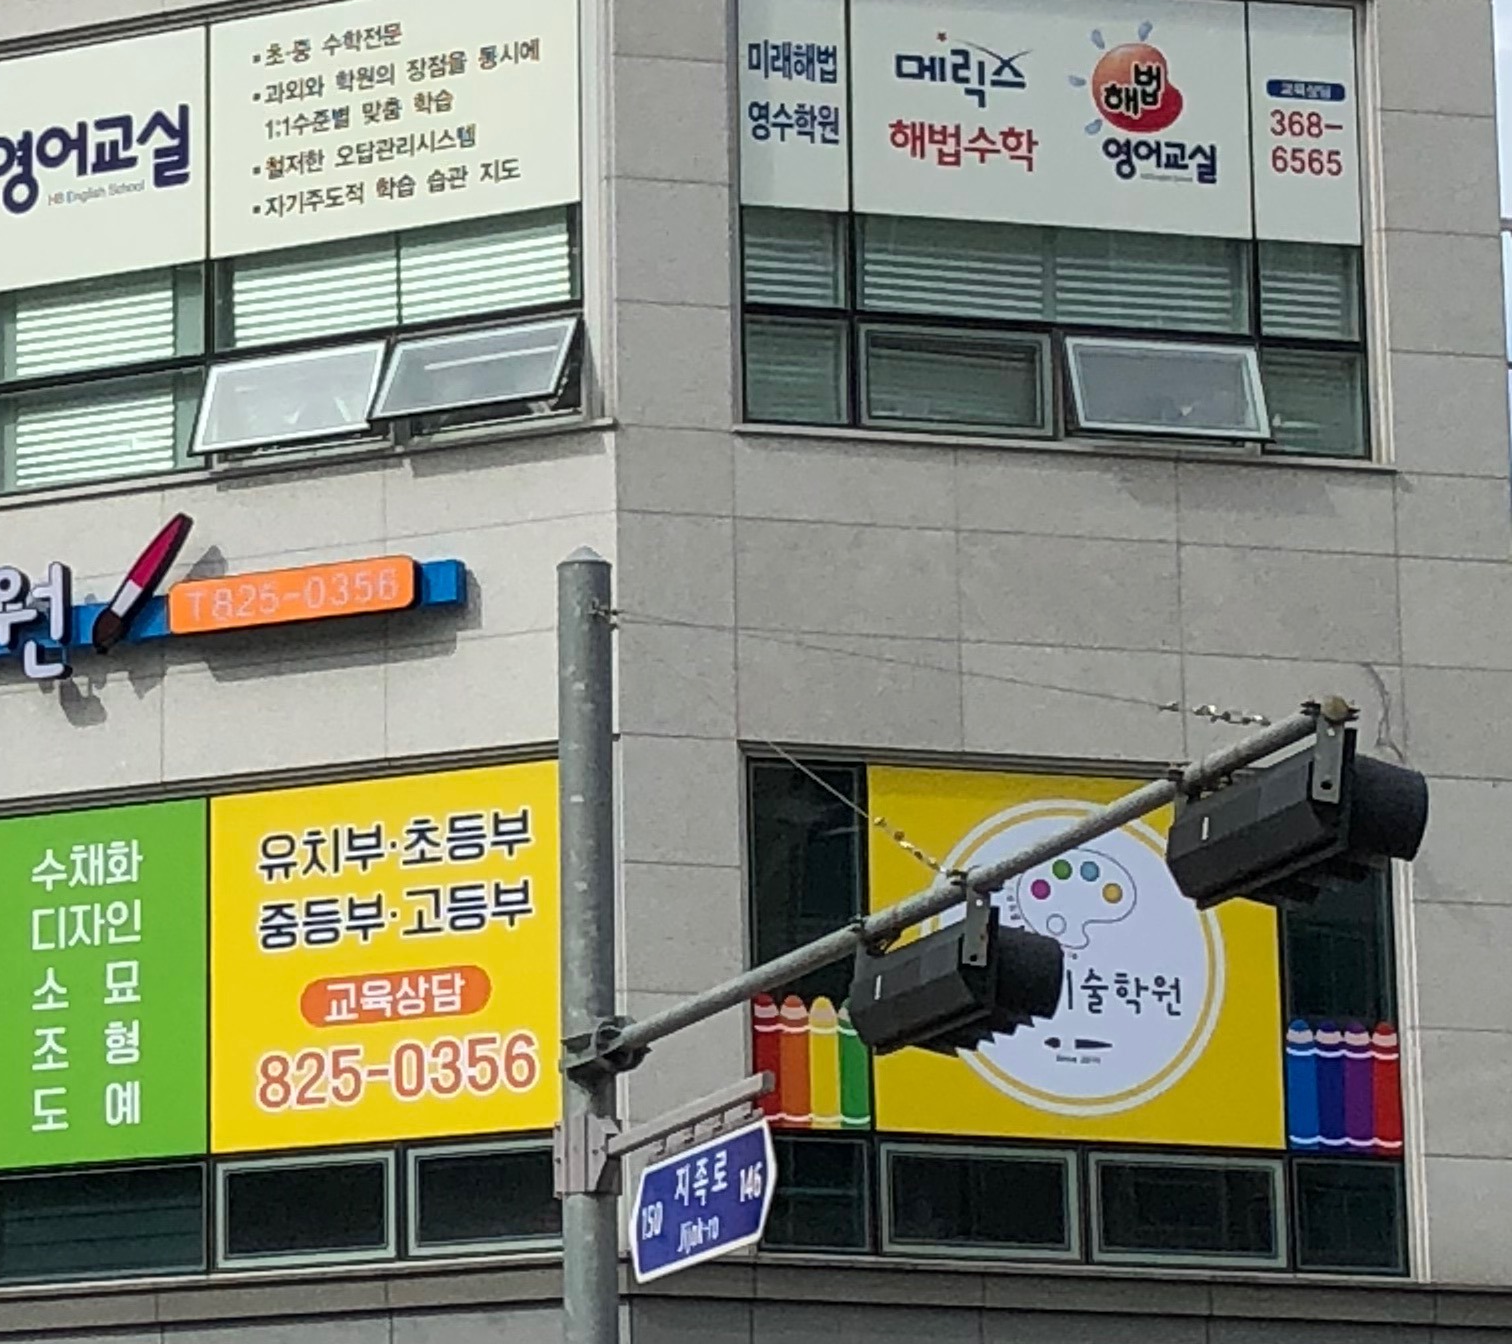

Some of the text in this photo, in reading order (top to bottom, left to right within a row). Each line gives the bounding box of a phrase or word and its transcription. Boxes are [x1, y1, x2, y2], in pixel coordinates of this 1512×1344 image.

[322, 22, 402, 55] 수학전문
[747, 39, 839, 85] 미래해법
[264, 38, 540, 104] 과외와 학원의 장점을 동시에
[895, 48, 1027, 108] 메릭스
[1102, 61, 1164, 116] 해법
[362, 97, 402, 126] 맞춤
[413, 89, 454, 114] 학습
[747, 101, 840, 146] 영수학원
[265, 123, 477, 180] 철저한 오답관리시스템
[889, 118, 1039, 172] 해법수학
[1102, 137, 1218, 184] 영어교실
[1271, 145, 1343, 176] 6565
[264, 158, 521, 218] 자기주도적 학습 습관 지도
[31, 840, 143, 892] 수채화
[32, 899, 142, 951] 디자인
[324, 971, 466, 1023] 교육상담
[257, 1031, 538, 1113] 825-0356
[674, 1150, 728, 1206] 지족로
